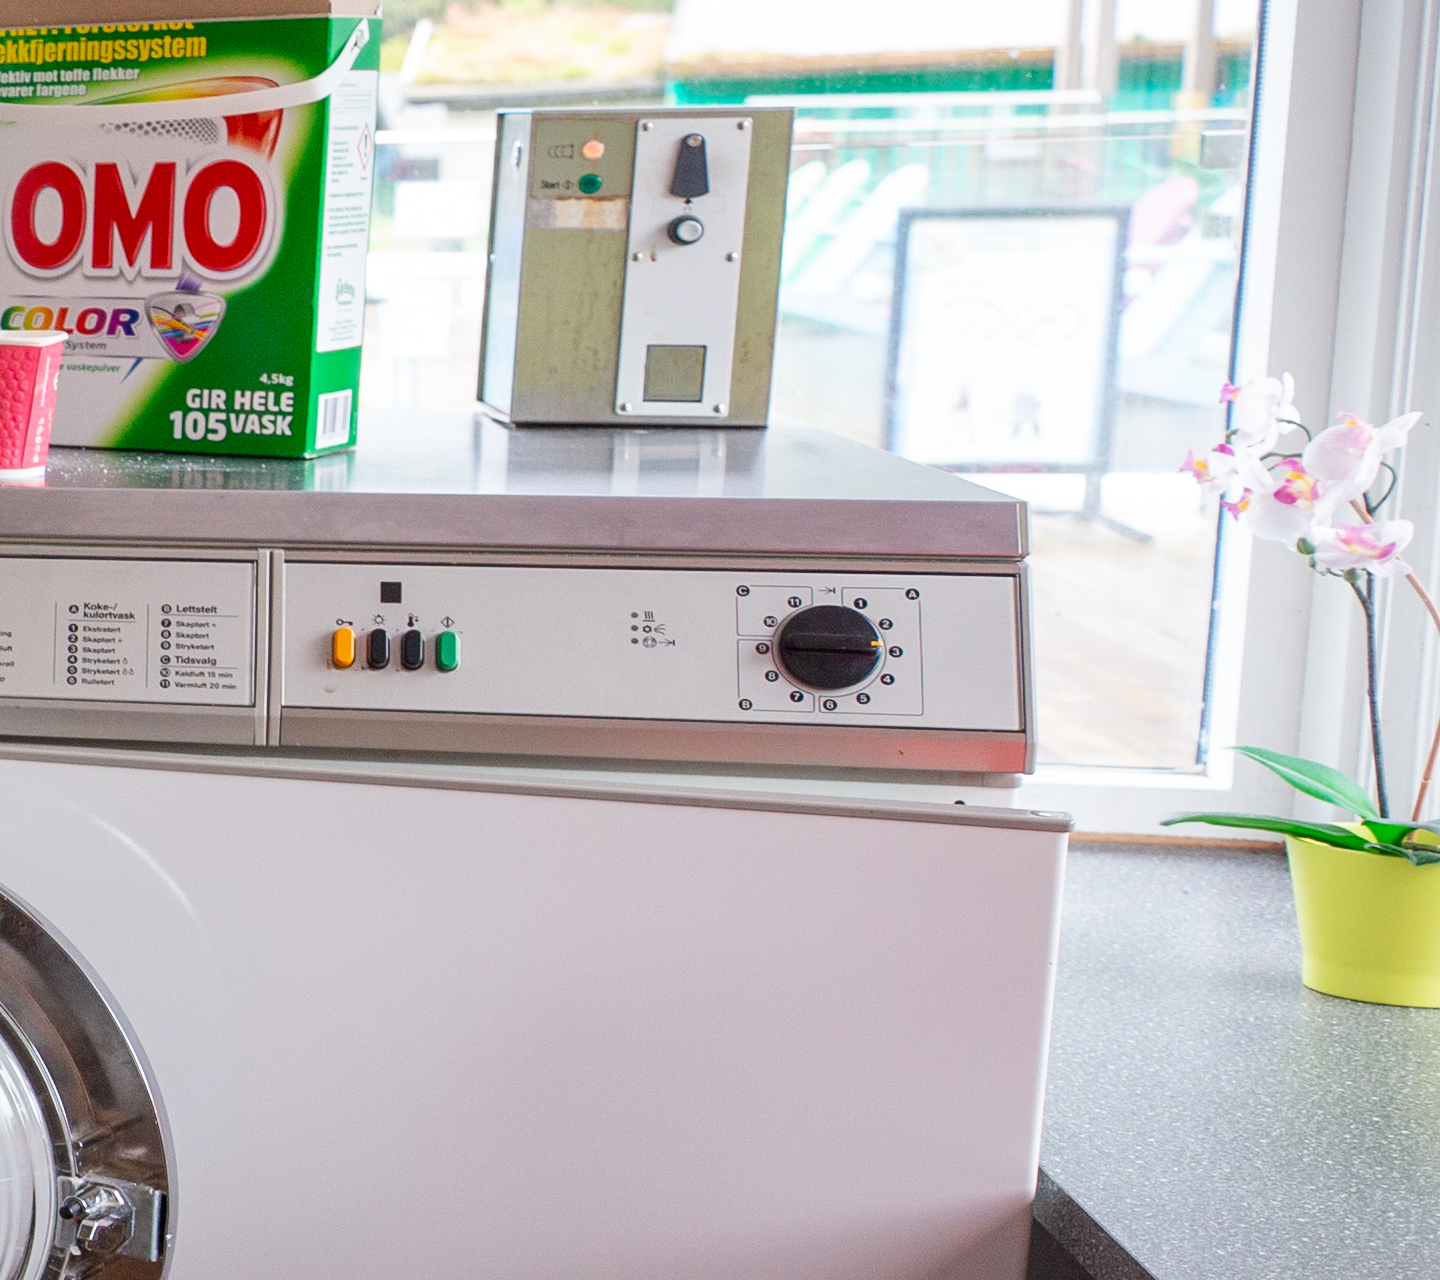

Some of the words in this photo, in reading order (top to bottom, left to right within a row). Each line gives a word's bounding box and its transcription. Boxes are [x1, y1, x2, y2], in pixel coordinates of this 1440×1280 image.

[34, 70, 57, 82] mot
[92, 68, 139, 80] flekker
[36, 84, 86, 98] fargene
[11, 159, 267, 272] OMO
[0, 306, 140, 336] COLOR
[65, 340, 106, 350] System
[67, 364, 120, 372] vaskepulver
[260, 373, 294, 386] 4,5kg
[186, 388, 226, 410] GIR
[234, 390, 294, 412] HELE
[169, 410, 227, 442] 105
[230, 413, 293, 436] VASK
[84, 602, 118, 611] Koke-/
[176, 605, 218, 614] Lettstelt
[174, 656, 216, 666] Tidsvalg
[175, 670, 205, 678] Kaldluft
